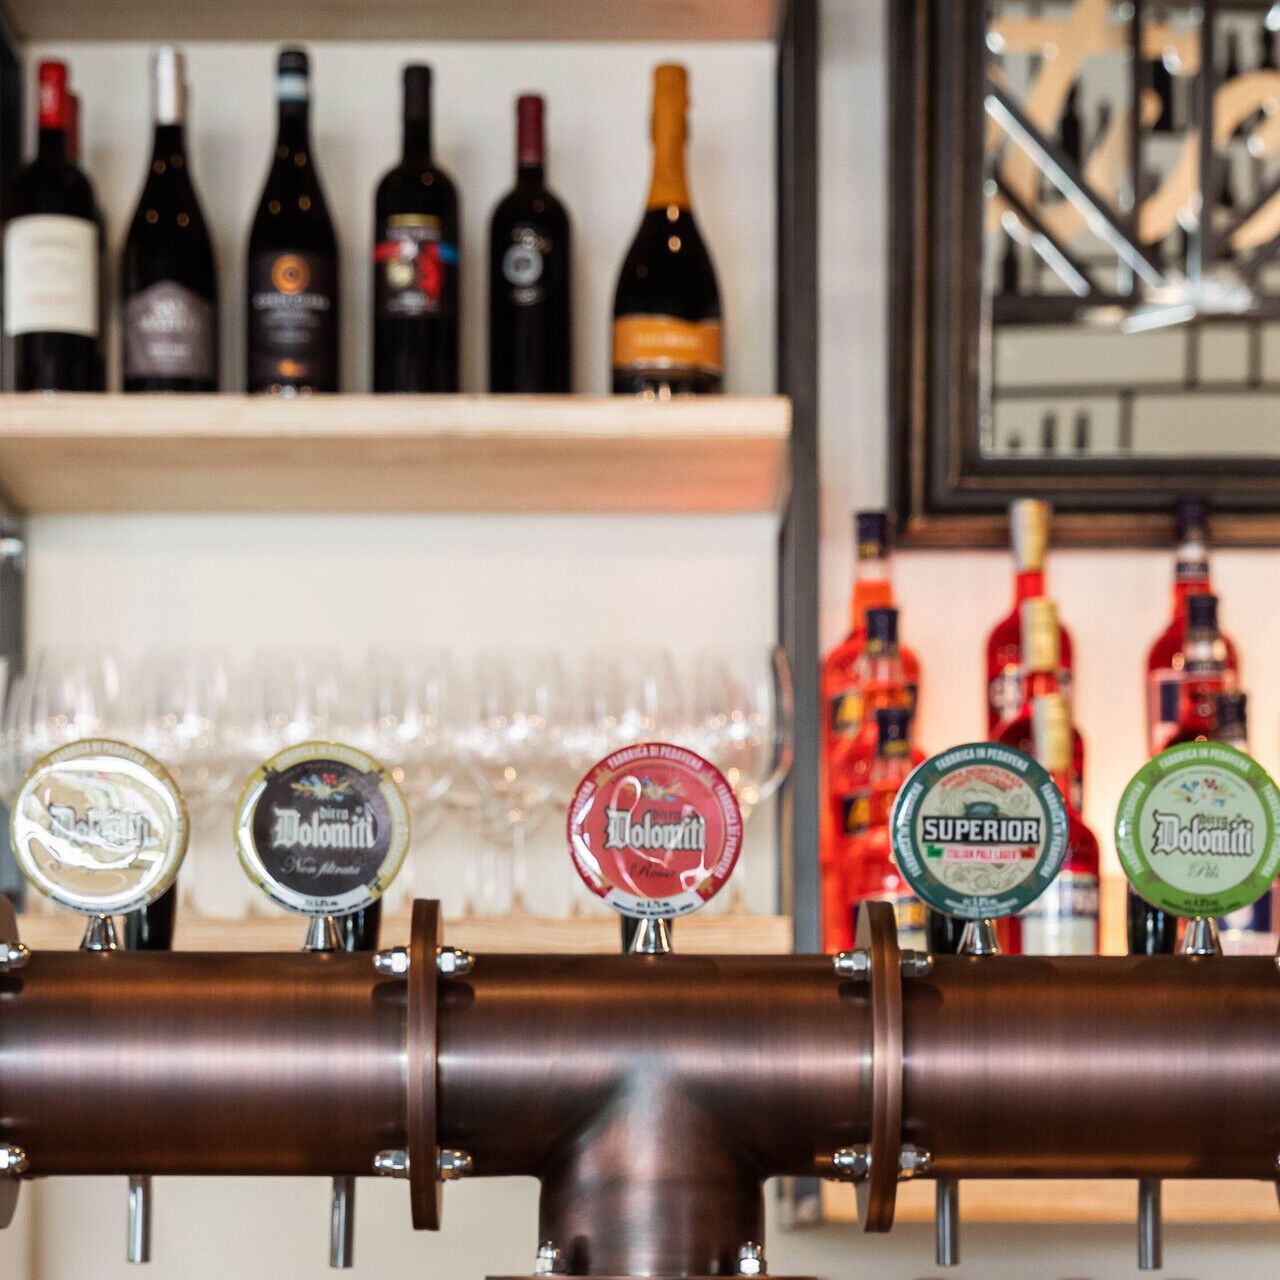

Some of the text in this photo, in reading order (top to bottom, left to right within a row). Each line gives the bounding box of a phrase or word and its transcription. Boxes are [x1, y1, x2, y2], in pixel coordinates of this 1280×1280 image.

[273, 806, 376, 849] Dolomiti
[604, 806, 706, 851] Dolomiti
[924, 818, 1039, 842] SUPERIOR
[1151, 810, 1254, 856] Dolomiti
